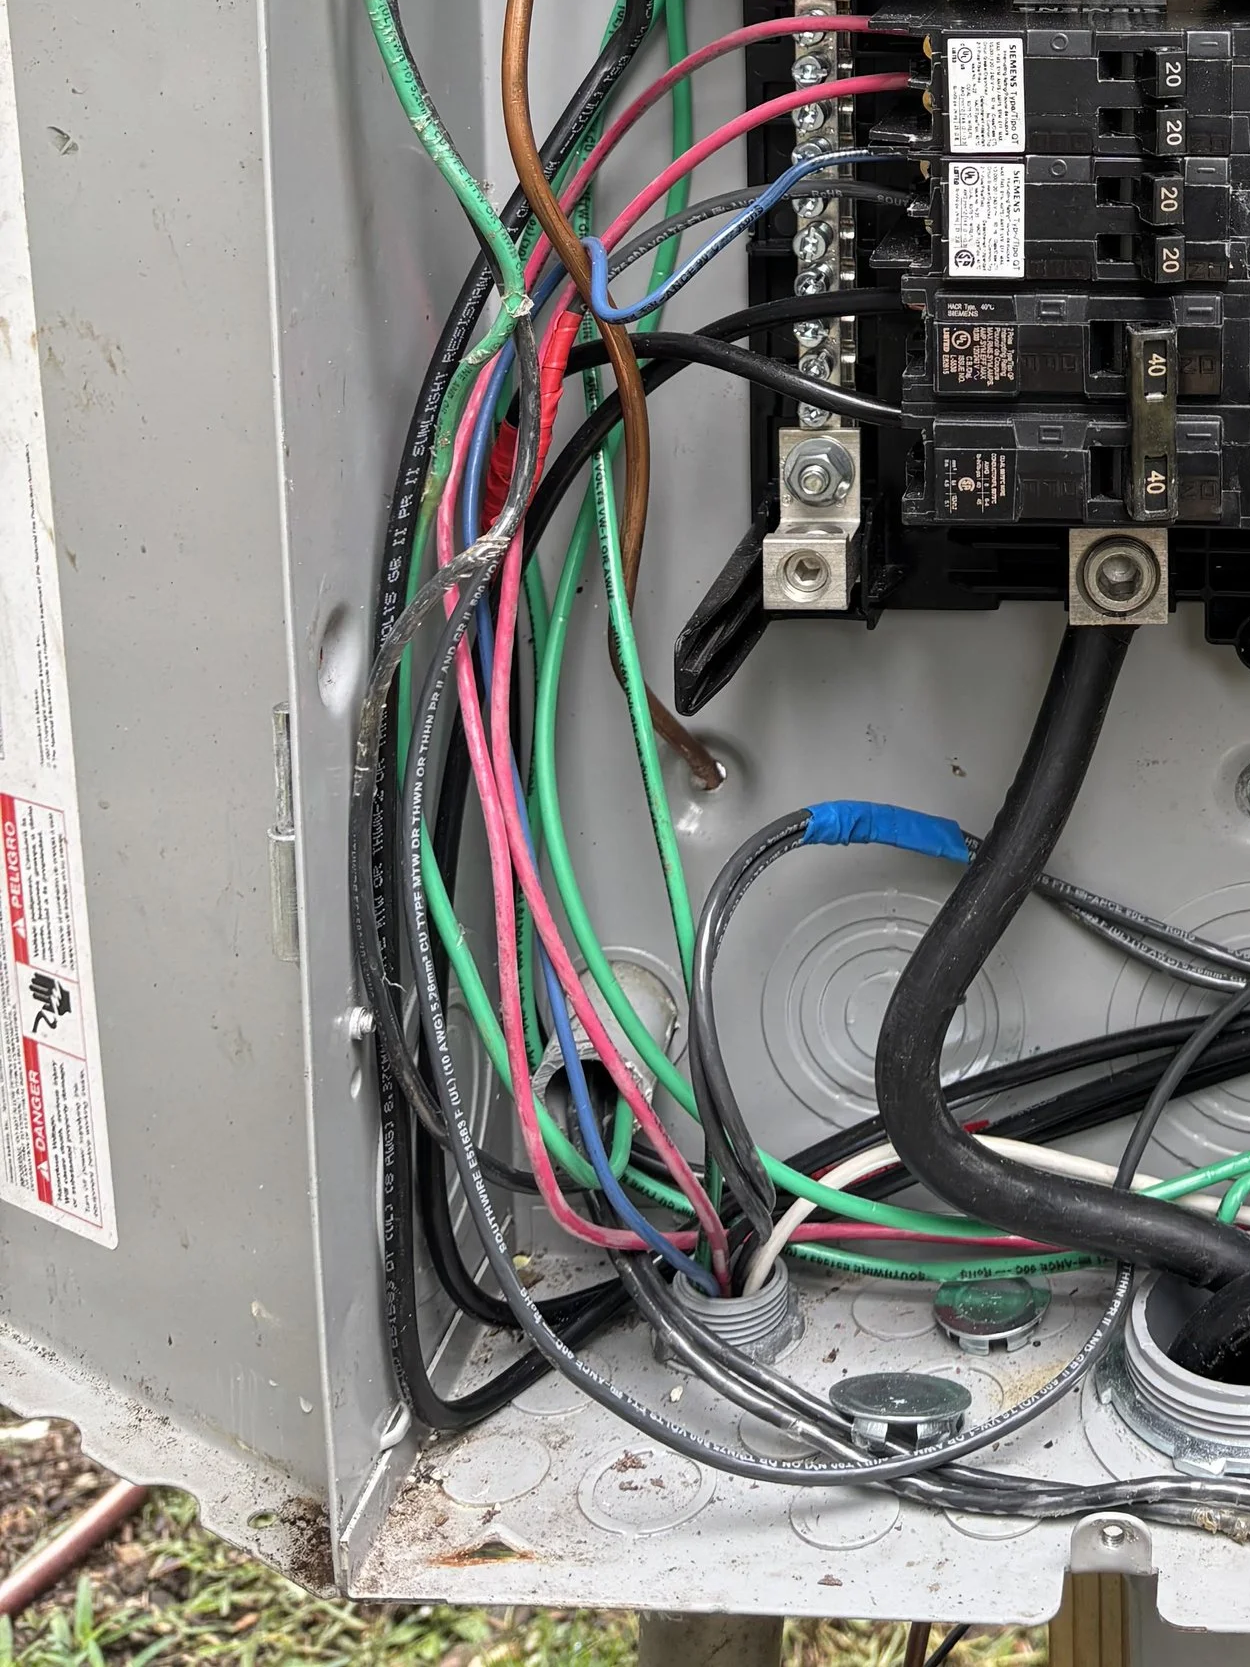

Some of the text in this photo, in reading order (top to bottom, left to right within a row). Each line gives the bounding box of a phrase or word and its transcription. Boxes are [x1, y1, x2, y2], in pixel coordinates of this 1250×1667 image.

[1009, 45, 1017, 87] SIEMENS
[1165, 61, 1182, 88] 20
[1011, 134, 1019, 145] QT
[1165, 120, 1182, 146] 20
[1160, 187, 1178, 212] 20
[1013, 260, 1020, 270] QT
[1162, 248, 1180, 273] 20
[1148, 353, 1166, 377] 40
[412, 371, 448, 457] SUNLIGHT
[1147, 471, 1165, 494] 40
[469, 585, 485, 606] 600
[454, 623, 467, 642] GR
[441, 646, 457, 673] AND
[427, 691, 440, 710] PR
[420, 714, 435, 753] THHN
[416, 757, 426, 777] OR
[412, 782, 423, 824] THWN
[410, 827, 421, 848] OR
[5, 822, 22, 908] PELIGRO
[411, 853, 422, 887] MTW
[414, 891, 425, 927] TYPE
[419, 932, 430, 952] CU
[432, 1013, 450, 1052] AWG)
[446, 1078, 462, 1105] (UL)
[30, 1070, 45, 1153] DANGER
[472, 1169, 508, 1254] SOUTHWIRE
